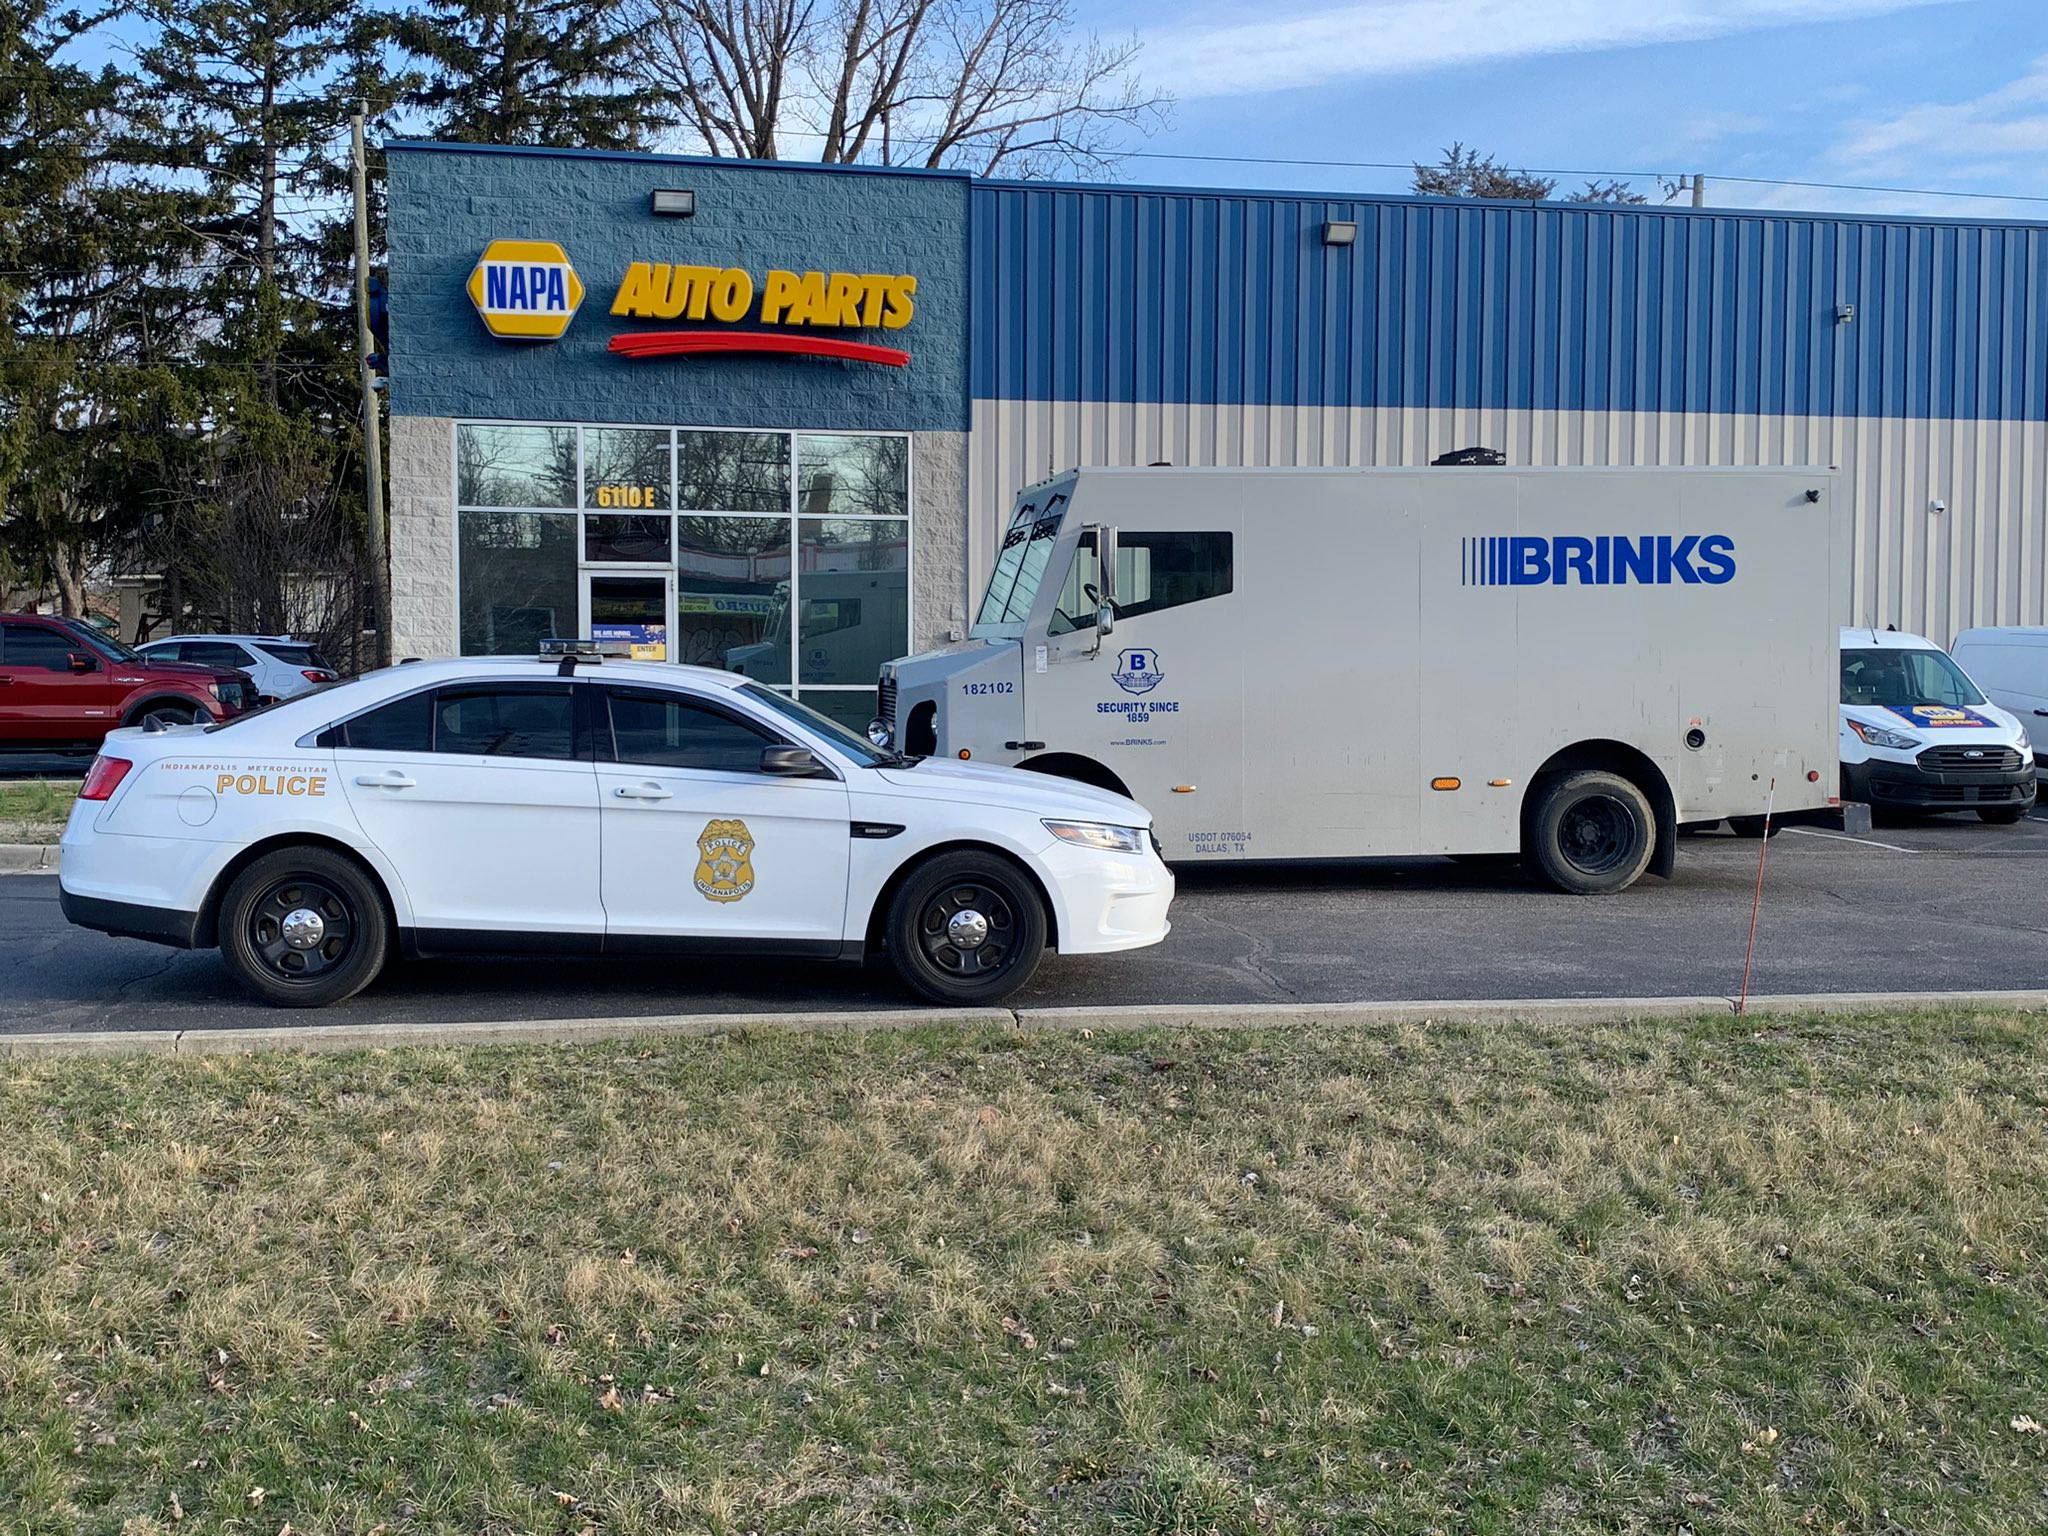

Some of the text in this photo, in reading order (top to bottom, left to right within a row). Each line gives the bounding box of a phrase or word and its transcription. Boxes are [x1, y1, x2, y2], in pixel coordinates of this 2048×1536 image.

[487, 265, 565, 311] NAPA
[609, 261, 917, 329] AUTO PARTS
[598, 486, 655, 508] 6110 E
[1508, 534, 1736, 585] BRINKS
[1130, 654, 1146, 671] B
[962, 681, 1014, 696] 182102
[1096, 702, 1179, 713] SECURITY SINCE
[1127, 712, 1150, 722] 1859
[1110, 738, 1167, 746] www.BRINKS.com
[161, 763, 328, 774] INDIANAPOLIS METROPOLITAN
[216, 774, 328, 797] POLICE
[706, 839, 746, 850] POLICE
[1188, 832, 1217, 842] USDOT
[1234, 842, 1245, 853] TX
[698, 880, 752, 897] INDIANAPOLIS
